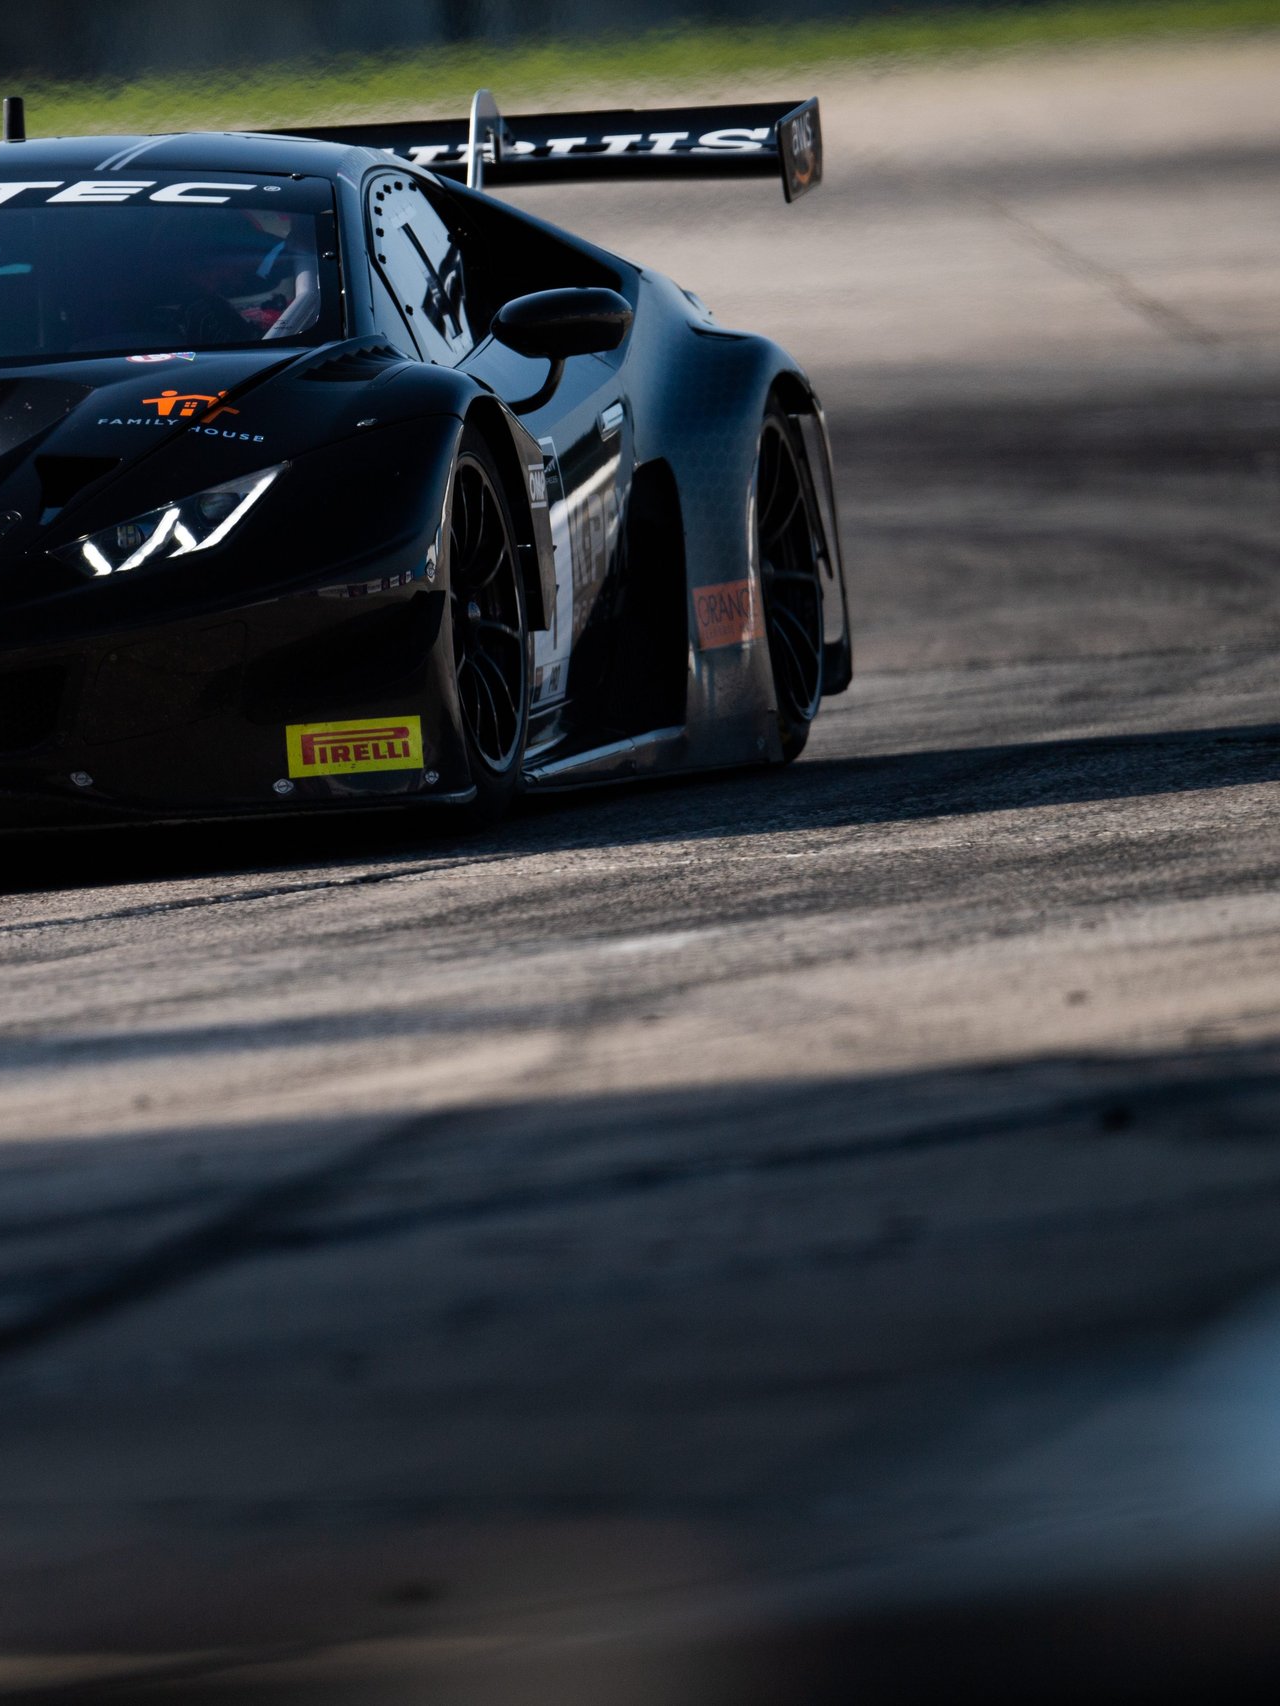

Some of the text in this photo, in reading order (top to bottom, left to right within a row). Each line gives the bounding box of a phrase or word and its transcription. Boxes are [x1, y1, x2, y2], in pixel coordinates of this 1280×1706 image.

[97, 417, 265, 443] FAMILY HOUSE
[301, 726, 410, 765] PIRELLI
